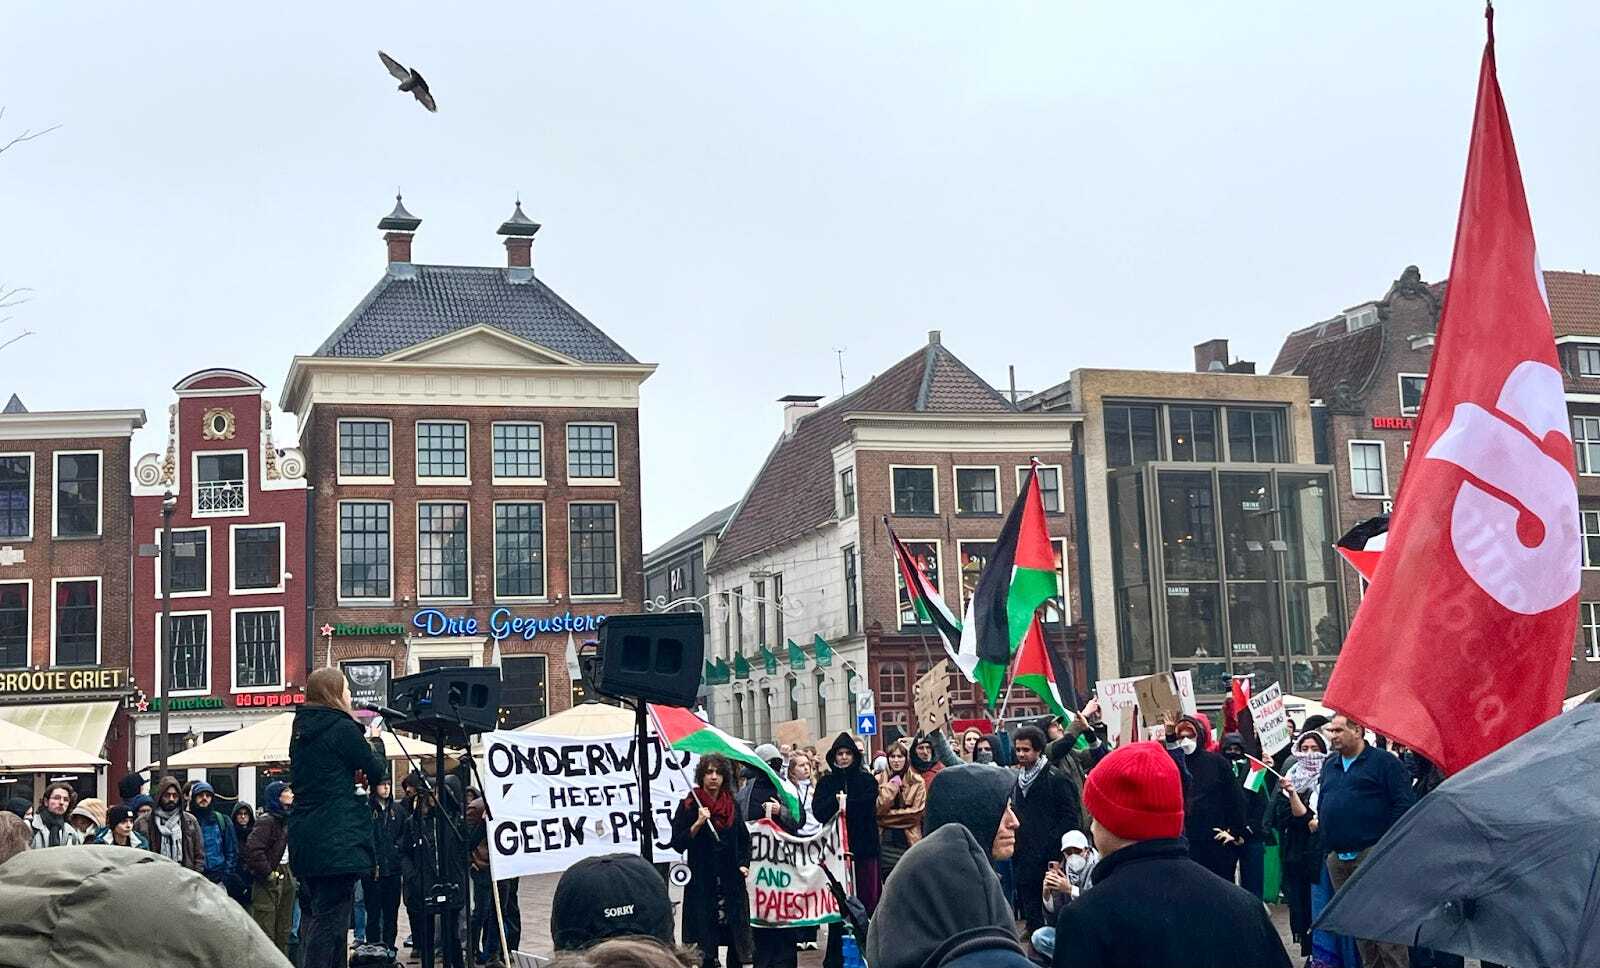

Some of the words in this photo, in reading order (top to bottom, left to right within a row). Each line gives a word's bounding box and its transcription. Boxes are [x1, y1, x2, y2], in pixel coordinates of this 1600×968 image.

[336, 624, 404, 636] Heineken
[413, 608, 477, 635] Drie
[0, 671, 66, 692] GROOTE
[69, 669, 122, 690] GRIET
[550, 782, 637, 808] HEEFT
[494, 815, 587, 855] GEEN
[755, 867, 791, 888] AND
[604, 904, 635, 918] SORRY
